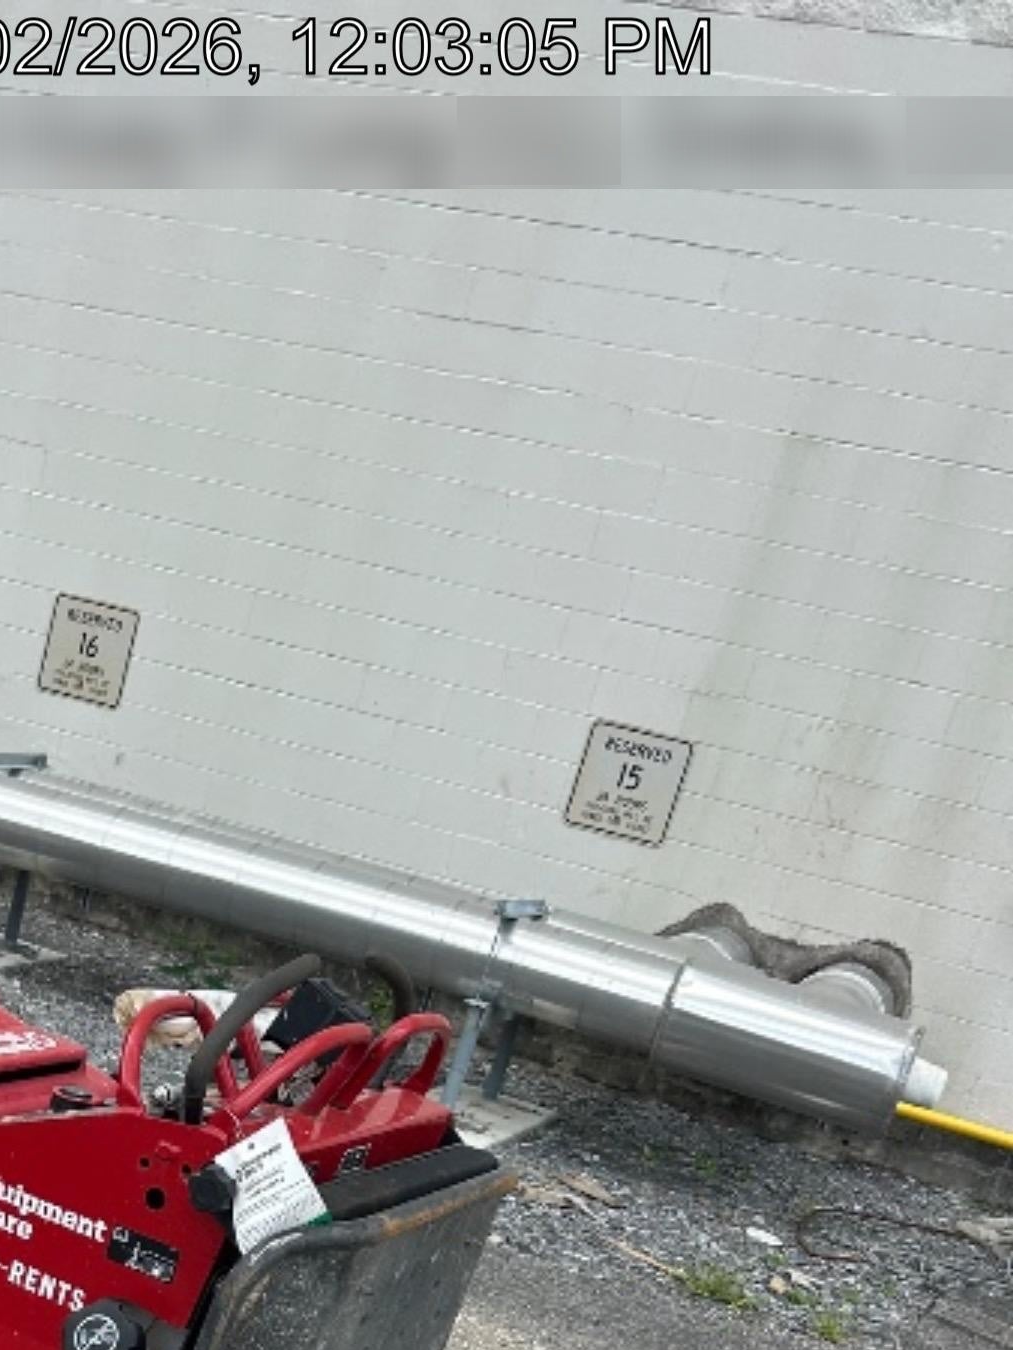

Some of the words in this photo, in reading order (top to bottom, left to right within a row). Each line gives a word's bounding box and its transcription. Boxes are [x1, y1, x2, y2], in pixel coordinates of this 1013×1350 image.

[79, 632, 99, 658] 16
[604, 736, 672, 764] RESERVED
[616, 762, 644, 790] 15
